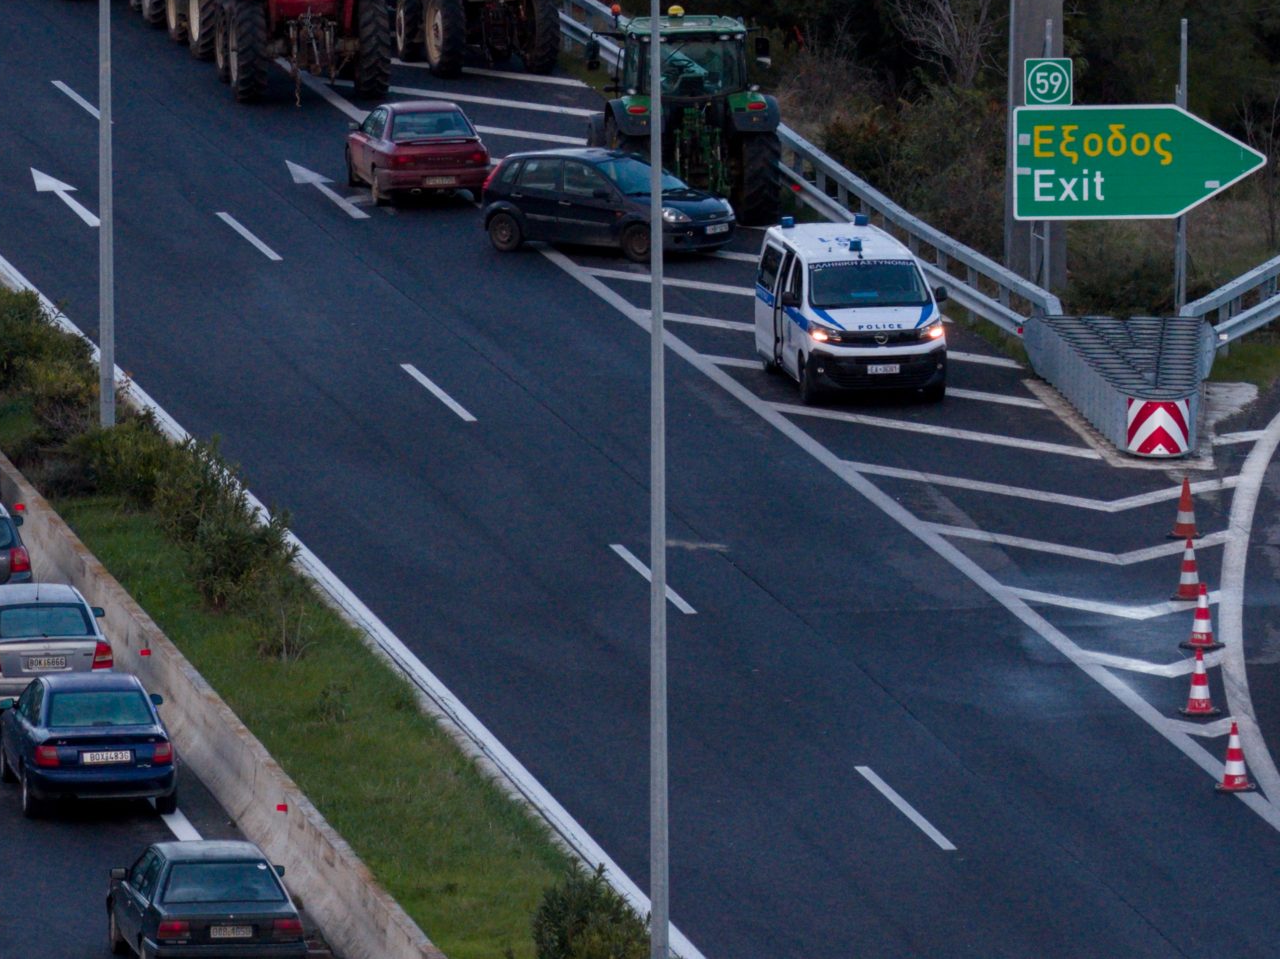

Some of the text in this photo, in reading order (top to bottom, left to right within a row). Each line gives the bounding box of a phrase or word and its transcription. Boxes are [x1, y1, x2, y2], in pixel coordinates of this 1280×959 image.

[1035, 72, 1063, 94] 59
[1033, 124, 1173, 165] Εξοδος
[1034, 169, 1105, 202] Exit
